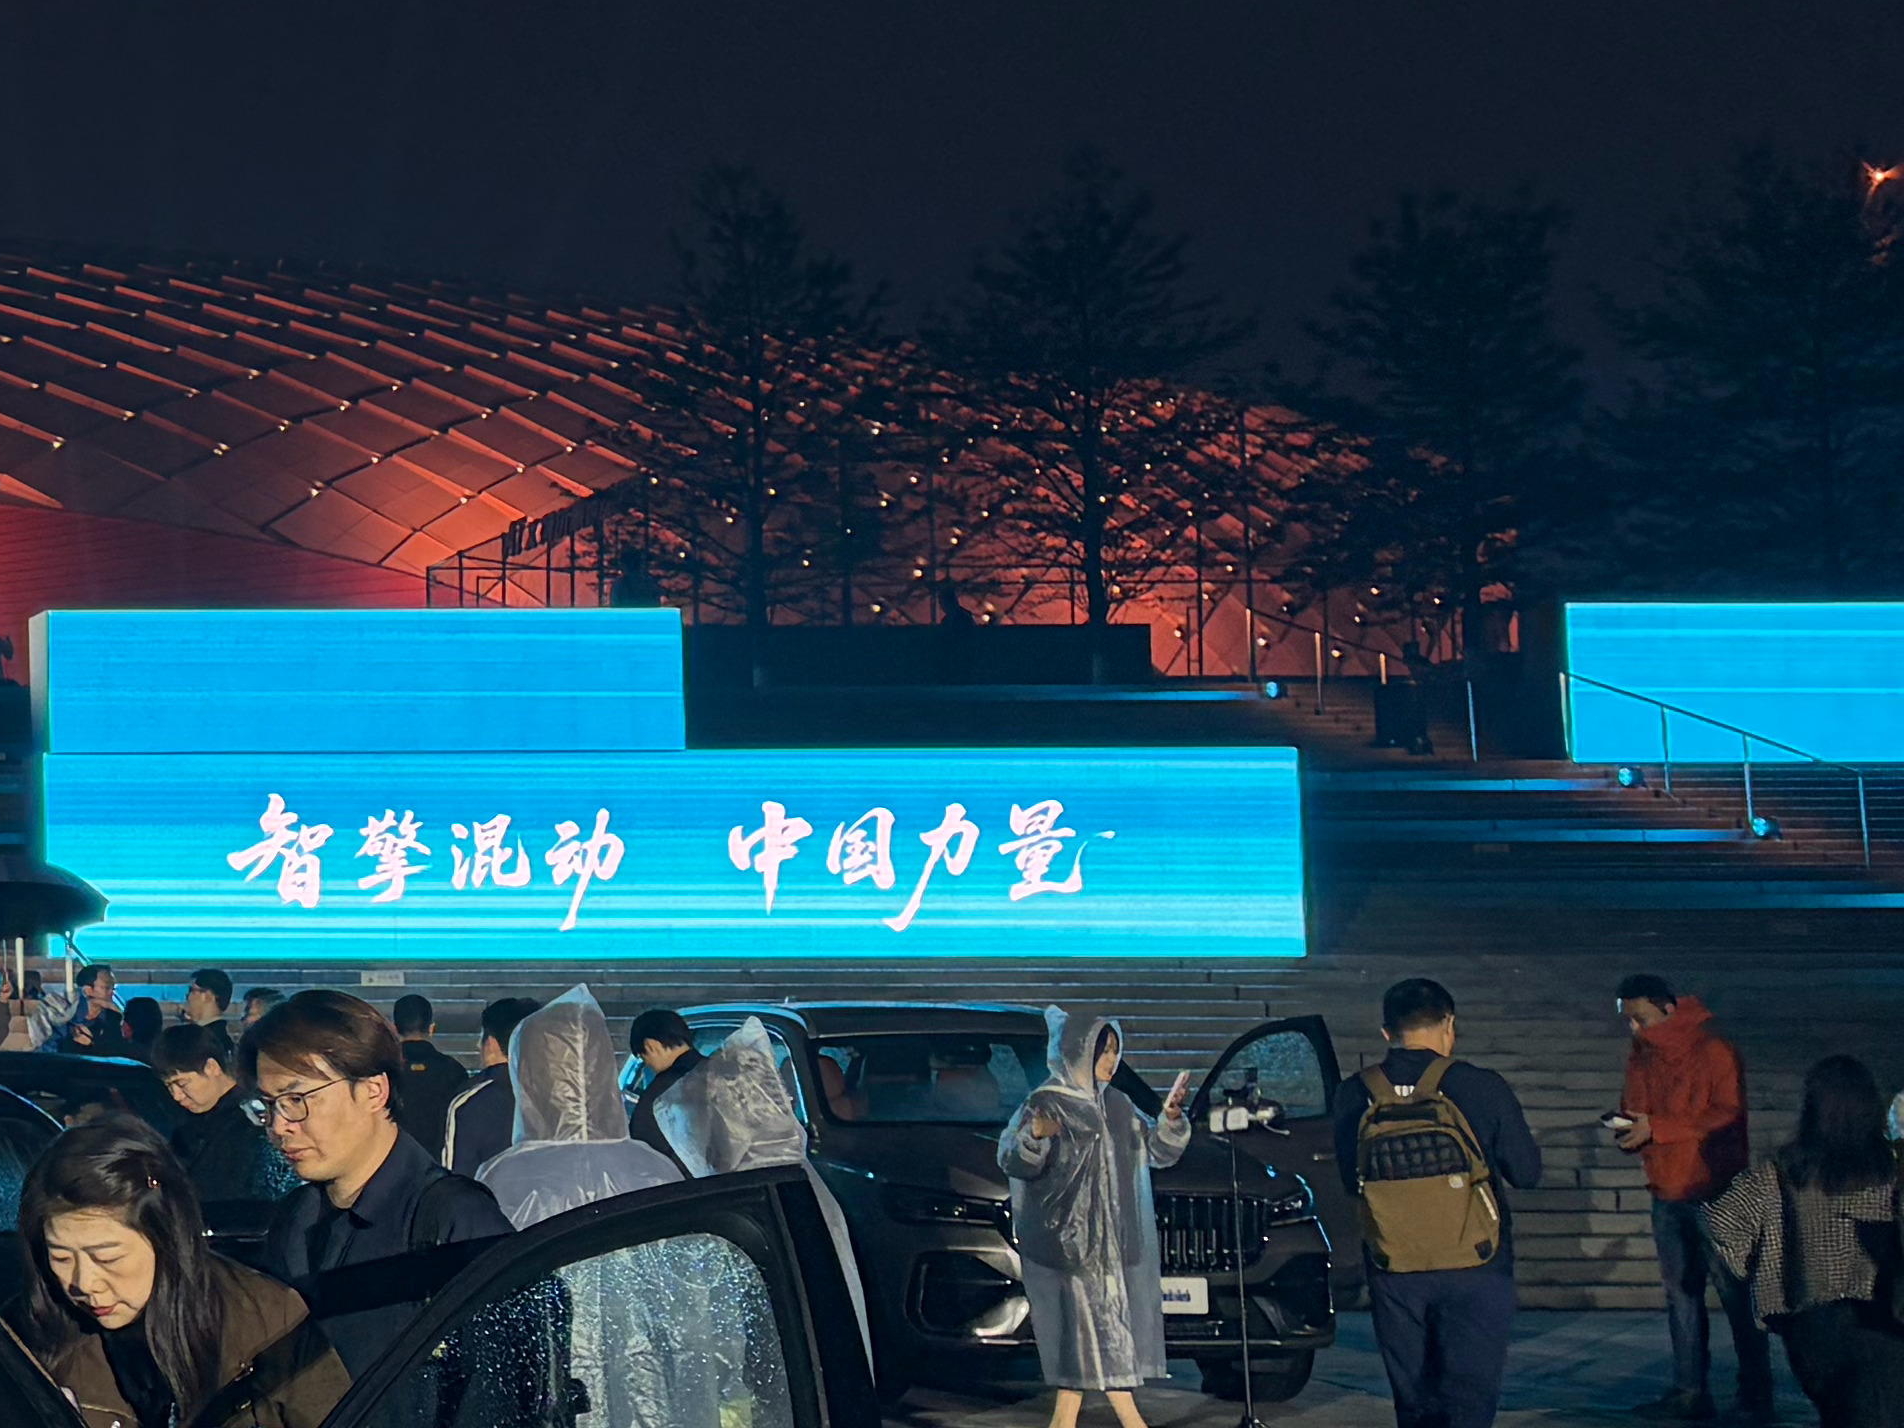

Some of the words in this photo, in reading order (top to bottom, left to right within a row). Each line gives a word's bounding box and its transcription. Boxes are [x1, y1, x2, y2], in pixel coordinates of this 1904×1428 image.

[227, 793, 626, 931] 智擎混动
[727, 798, 1115, 932] 中国力量
